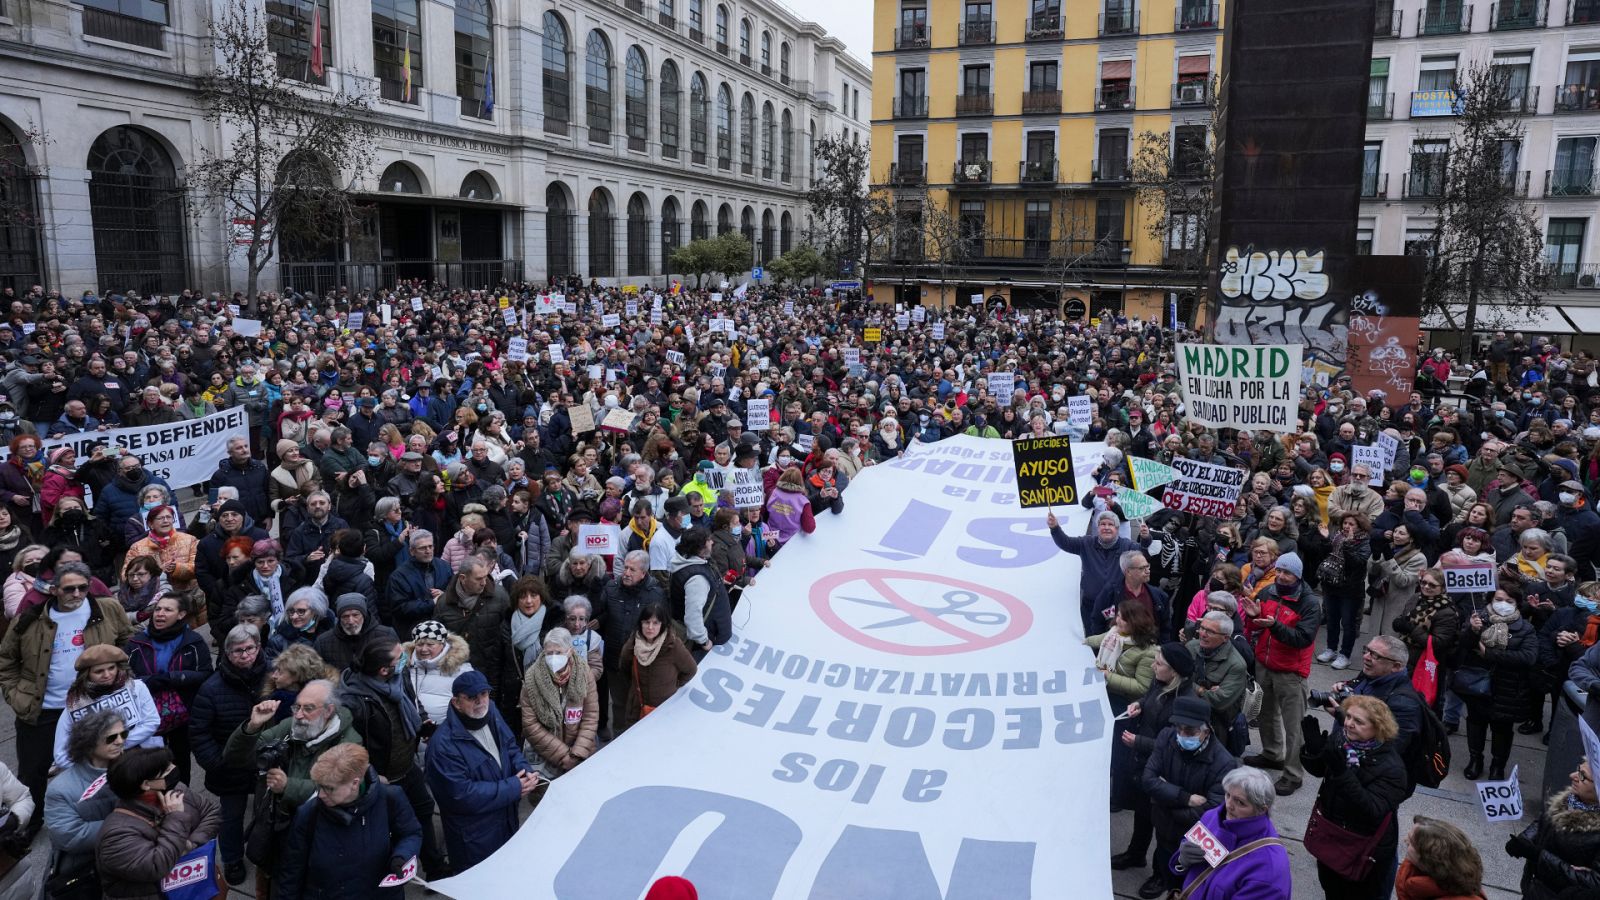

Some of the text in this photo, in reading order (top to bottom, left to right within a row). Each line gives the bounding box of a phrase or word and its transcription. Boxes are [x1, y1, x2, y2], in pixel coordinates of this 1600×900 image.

[1415, 91, 1457, 100] HOSTAL
[382, 128, 424, 143] SUPERIOR
[426, 134, 438, 145] DE
[469, 141, 479, 151] DE
[480, 143, 510, 156] MADRID
[1184, 346, 1290, 378] MADRID
[1188, 377, 1290, 400] EN LUCHA POR LA
[1233, 405, 1287, 425] PUBLICA
[115, 434, 142, 450] SE
[146, 411, 243, 447] DEFIENDE!
[180, 445, 196, 459] DE
[1016, 441, 1030, 452] TU
[1019, 457, 1069, 477] AYUSO
[1172, 460, 1245, 486] SOY EL NUEVO
[735, 484, 762, 496] ¡ROBAN
[735, 495, 762, 504] SALUD!
[1163, 491, 1236, 517] OS ESPERO
[587, 536, 607, 544] NO+
[1446, 569, 1492, 587] Basta!
[713, 633, 1067, 697] PRIVATIZACIONES
[73, 691, 130, 722] SE VENDE
[688, 667, 1105, 750] RECORTES
[772, 751, 948, 804] a los
[553, 785, 1037, 900] NO
[1192, 826, 1222, 858] NO+
[164, 862, 203, 883] NO+
